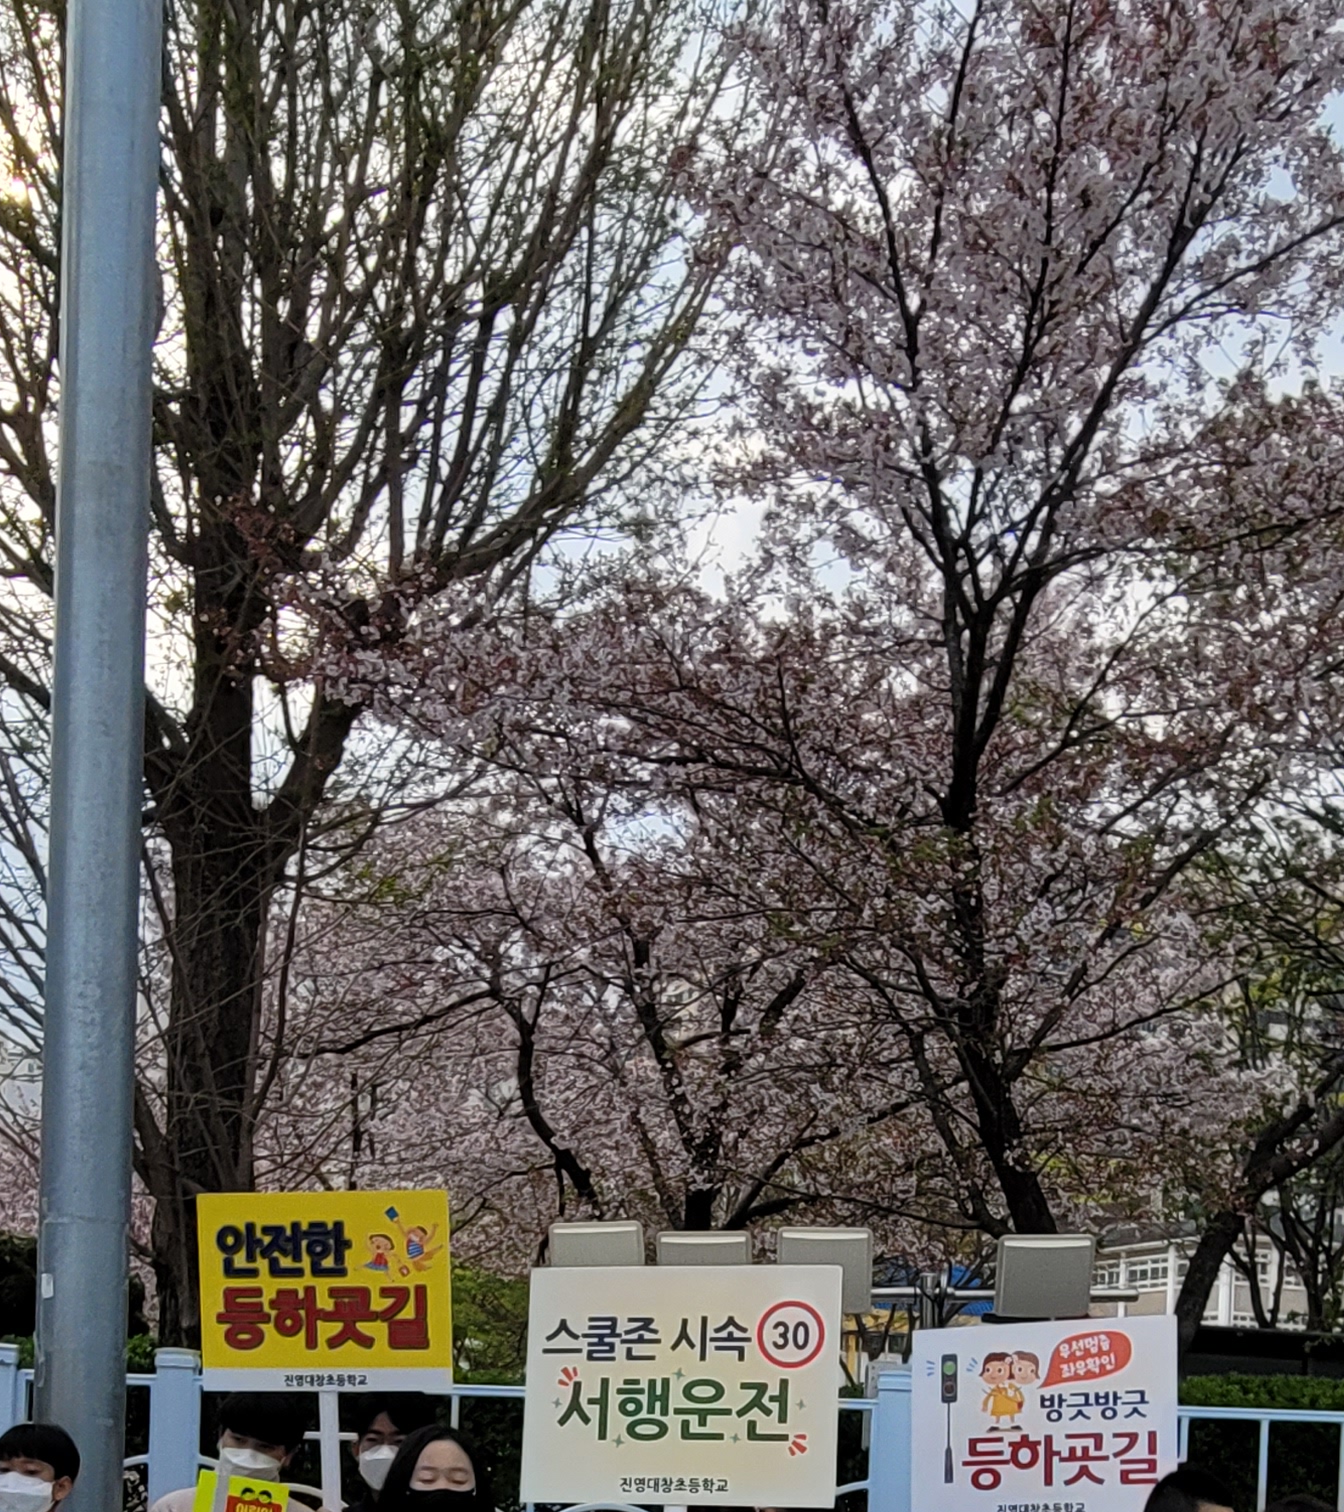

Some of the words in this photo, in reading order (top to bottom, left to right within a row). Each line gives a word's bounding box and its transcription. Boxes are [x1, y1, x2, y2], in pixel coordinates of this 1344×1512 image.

[215, 1220, 352, 1279] 안전한
[216, 1284, 431, 1352] 등하굣길
[542, 1316, 661, 1362] 스쿨존
[670, 1315, 752, 1362] 시속
[772, 1321, 810, 1351] 30
[283, 1373, 369, 1388] 진영대창초등학교
[1040, 1390, 1149, 1422] 방긋방긋
[557, 1377, 790, 1442] 서행운전
[619, 1477, 729, 1493] 진영대창초등학교
[961, 1430, 1158, 1490] 등하굣길
